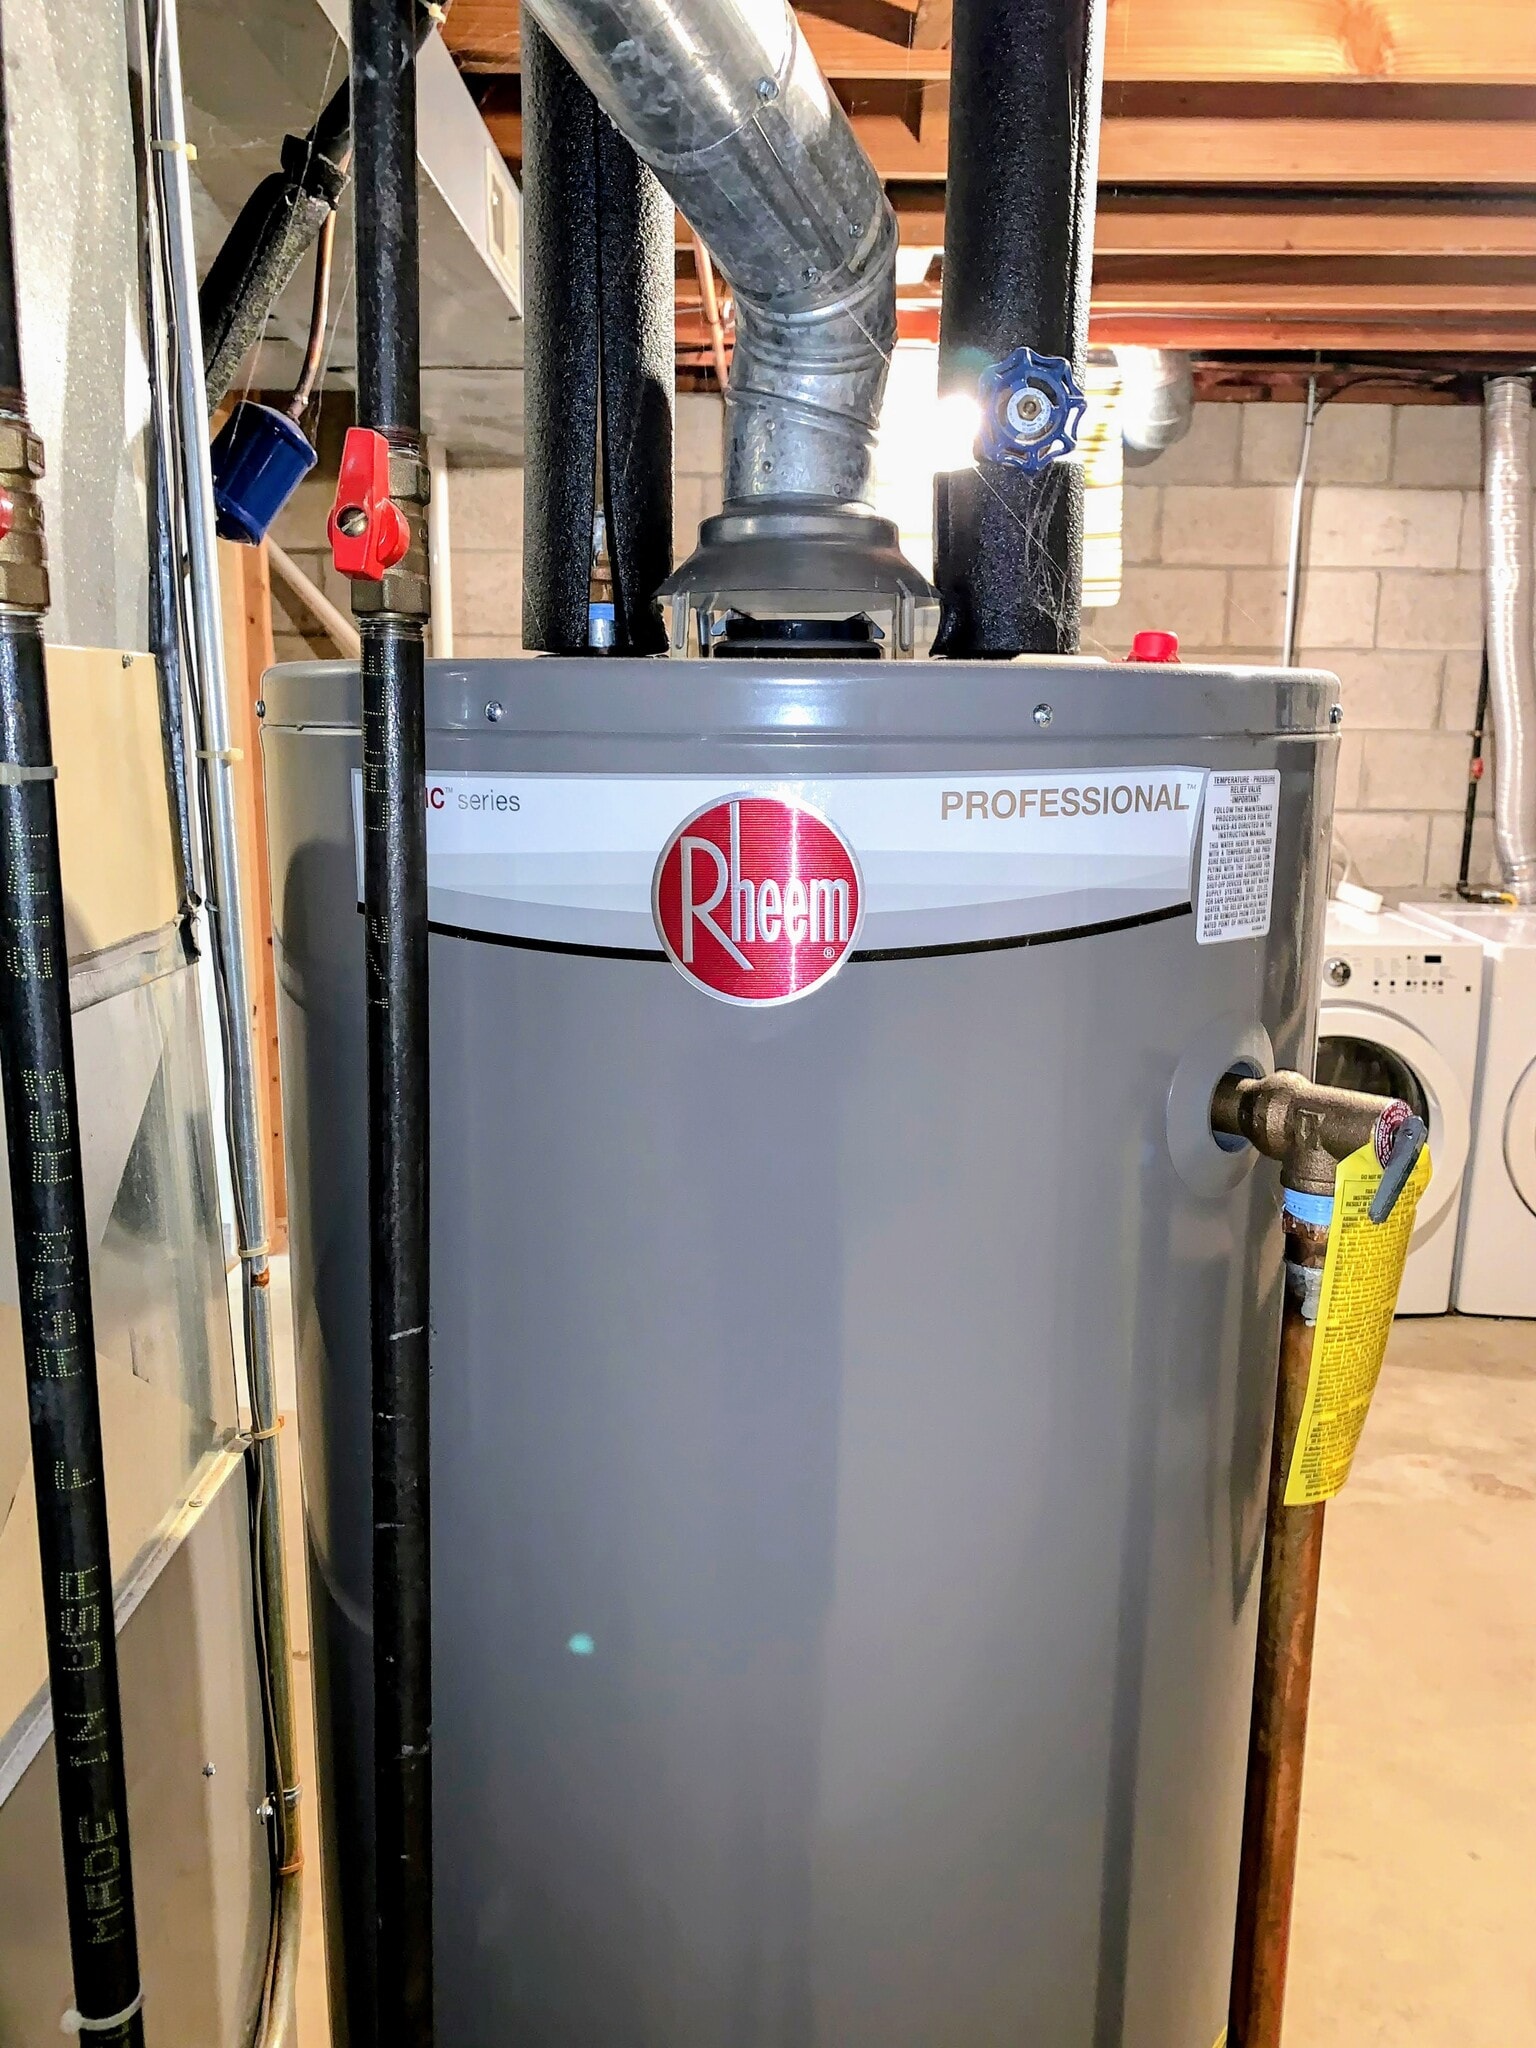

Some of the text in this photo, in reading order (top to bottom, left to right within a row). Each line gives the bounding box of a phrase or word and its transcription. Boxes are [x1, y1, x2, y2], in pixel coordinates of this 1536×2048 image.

[1214, 776, 1249, 784] TEMPERATURE
[1254, 775, 1275, 783] PRESSURE
[458, 789, 521, 812] series
[1206, 889, 1222, 897] SUPPLY
[1225, 895, 1244, 903] OPERATION
[1218, 920, 1229, 928] POINT
[1237, 917, 1260, 925] INSTALLATION
[21, 1068, 73, 1184] A53
[31, 1228, 83, 1378] ASTM
[53, 1460, 97, 1491] F
[59, 1564, 102, 1671] USA
[64, 1707, 109, 1767] IN
[78, 1810, 125, 1944] MADE
